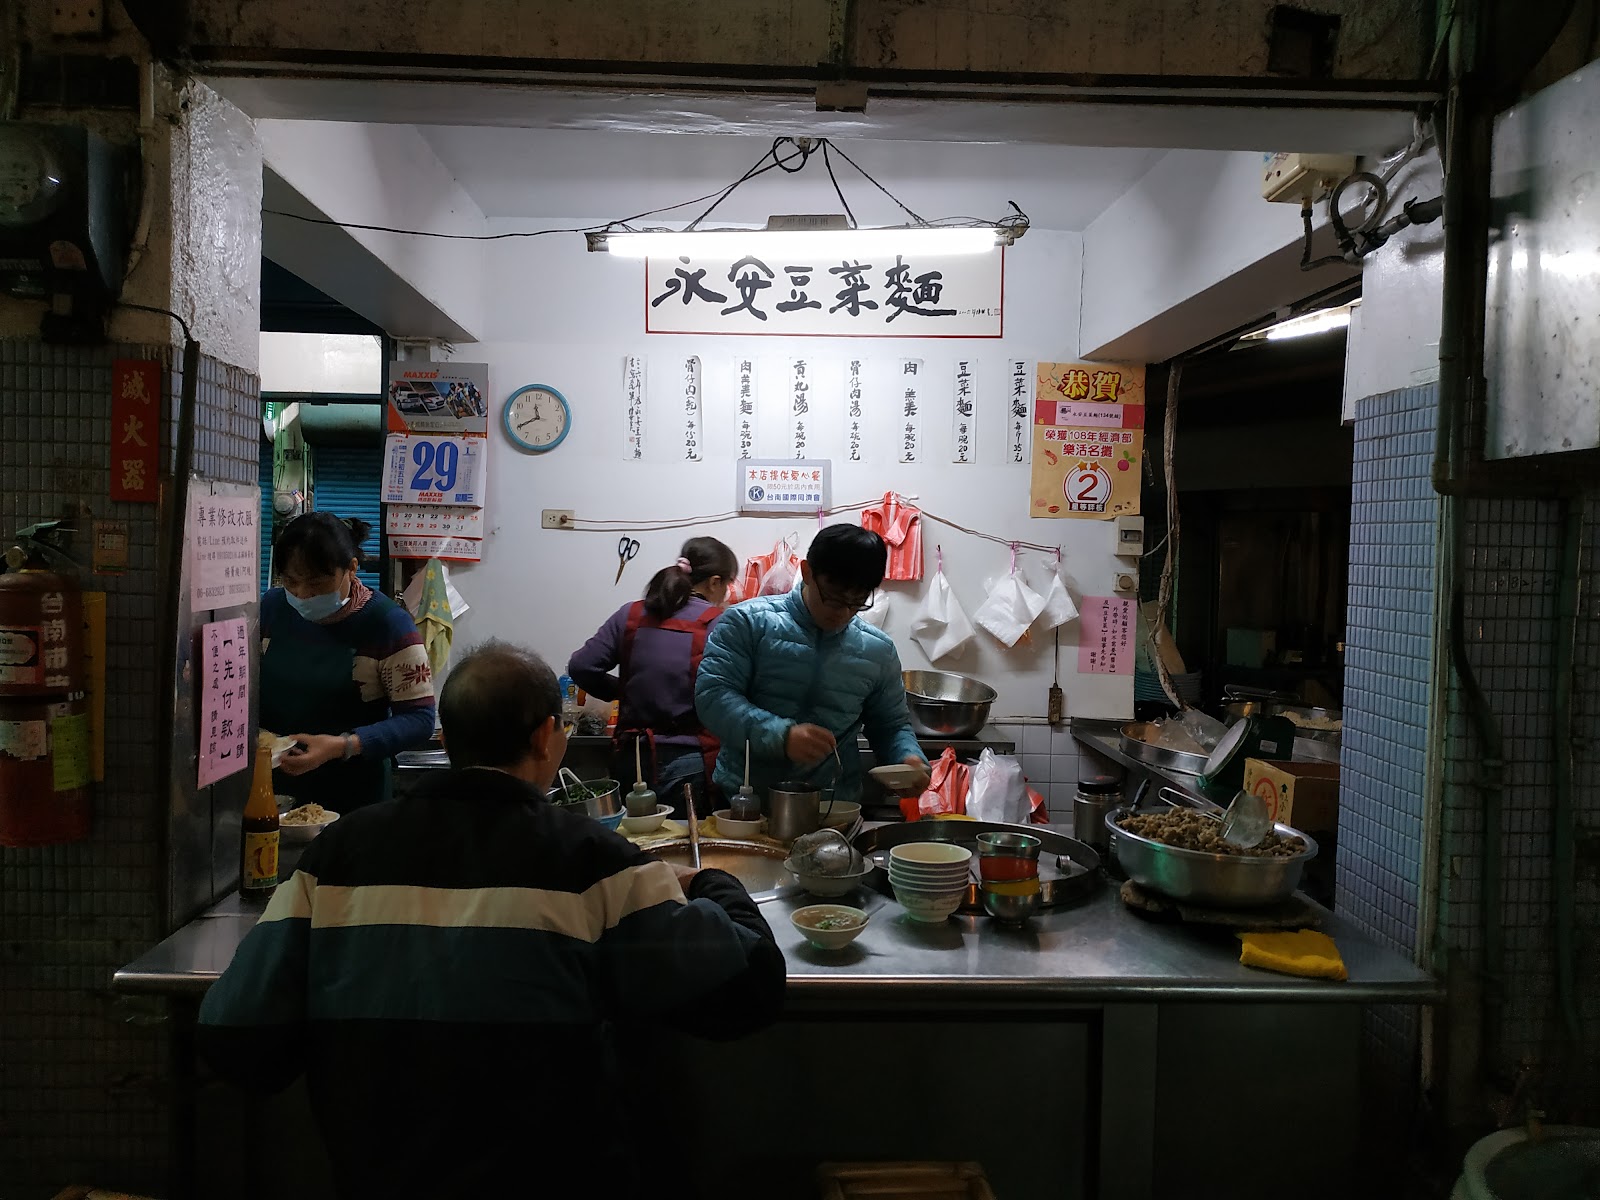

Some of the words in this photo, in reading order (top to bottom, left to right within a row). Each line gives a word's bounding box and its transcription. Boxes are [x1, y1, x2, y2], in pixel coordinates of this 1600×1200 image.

[652, 255, 957, 322] 永安豆菜麵
[403, 371, 438, 379] MAXXIS
[1060, 369, 1121, 402] 恭賀
[121, 369, 151, 490] 滅火器
[1045, 430, 1133, 443] 榮獲108年經濟部
[1063, 443, 1113, 457] 樂活名攤
[410, 441, 459, 492] 29
[749, 470, 820, 481] 本店提供愛心餐
[767, 493, 820, 502] 台南國際同濟會
[1077, 473, 1098, 501] 2
[197, 506, 253, 527] 專業修改衣服
[220, 639, 235, 759] 【先付款】
